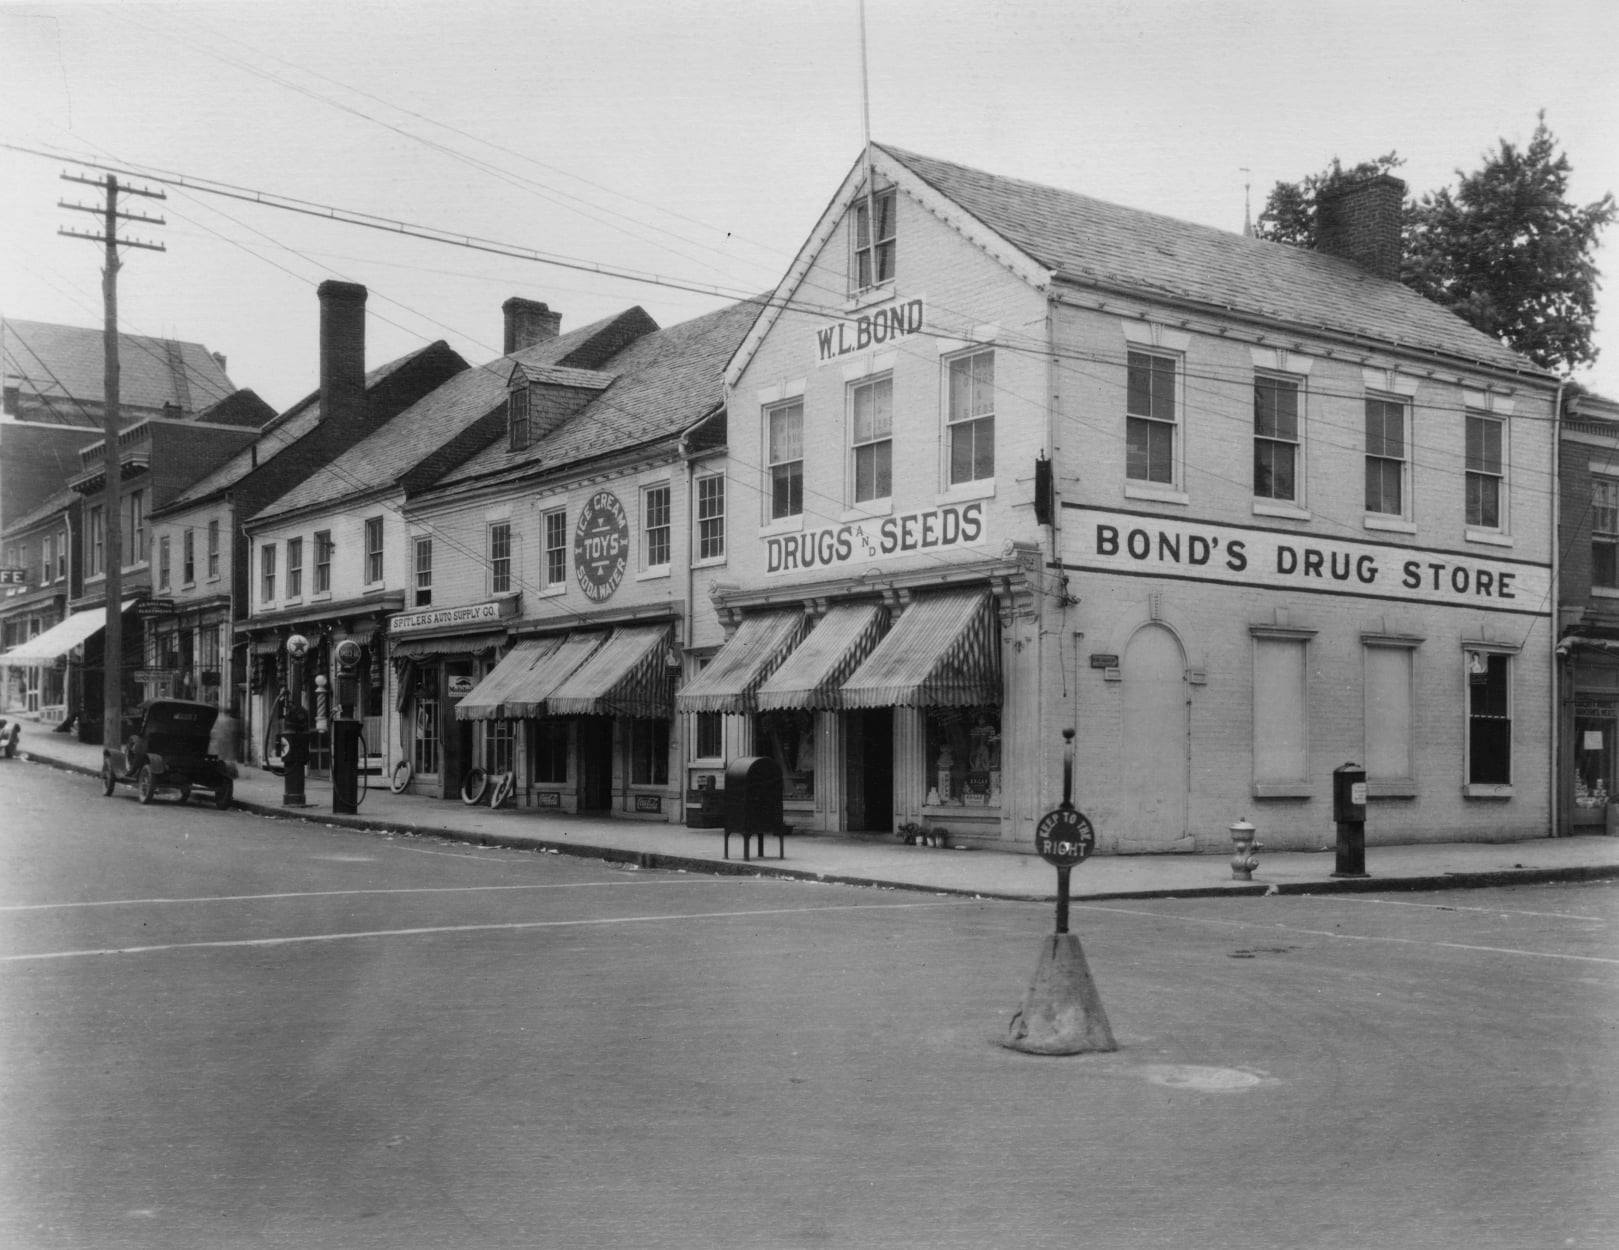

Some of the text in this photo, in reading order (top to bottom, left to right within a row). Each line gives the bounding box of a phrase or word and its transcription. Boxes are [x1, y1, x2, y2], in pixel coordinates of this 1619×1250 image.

[856, 299, 923, 351] BOND
[576, 493, 626, 536] ICE CREAM
[584, 533, 619, 560] TOYS
[766, 503, 982, 573] DRUGS AND SEEDS
[577, 557, 626, 601] SODA WATER
[1096, 524, 1516, 599] BOND'S DRUG STORE
[434, 612, 452, 624] AUTO
[453, 607, 480, 622] SUPPLY
[1039, 812, 1092, 841] KEEP TO THE
[1043, 840, 1087, 856] RIGHT
